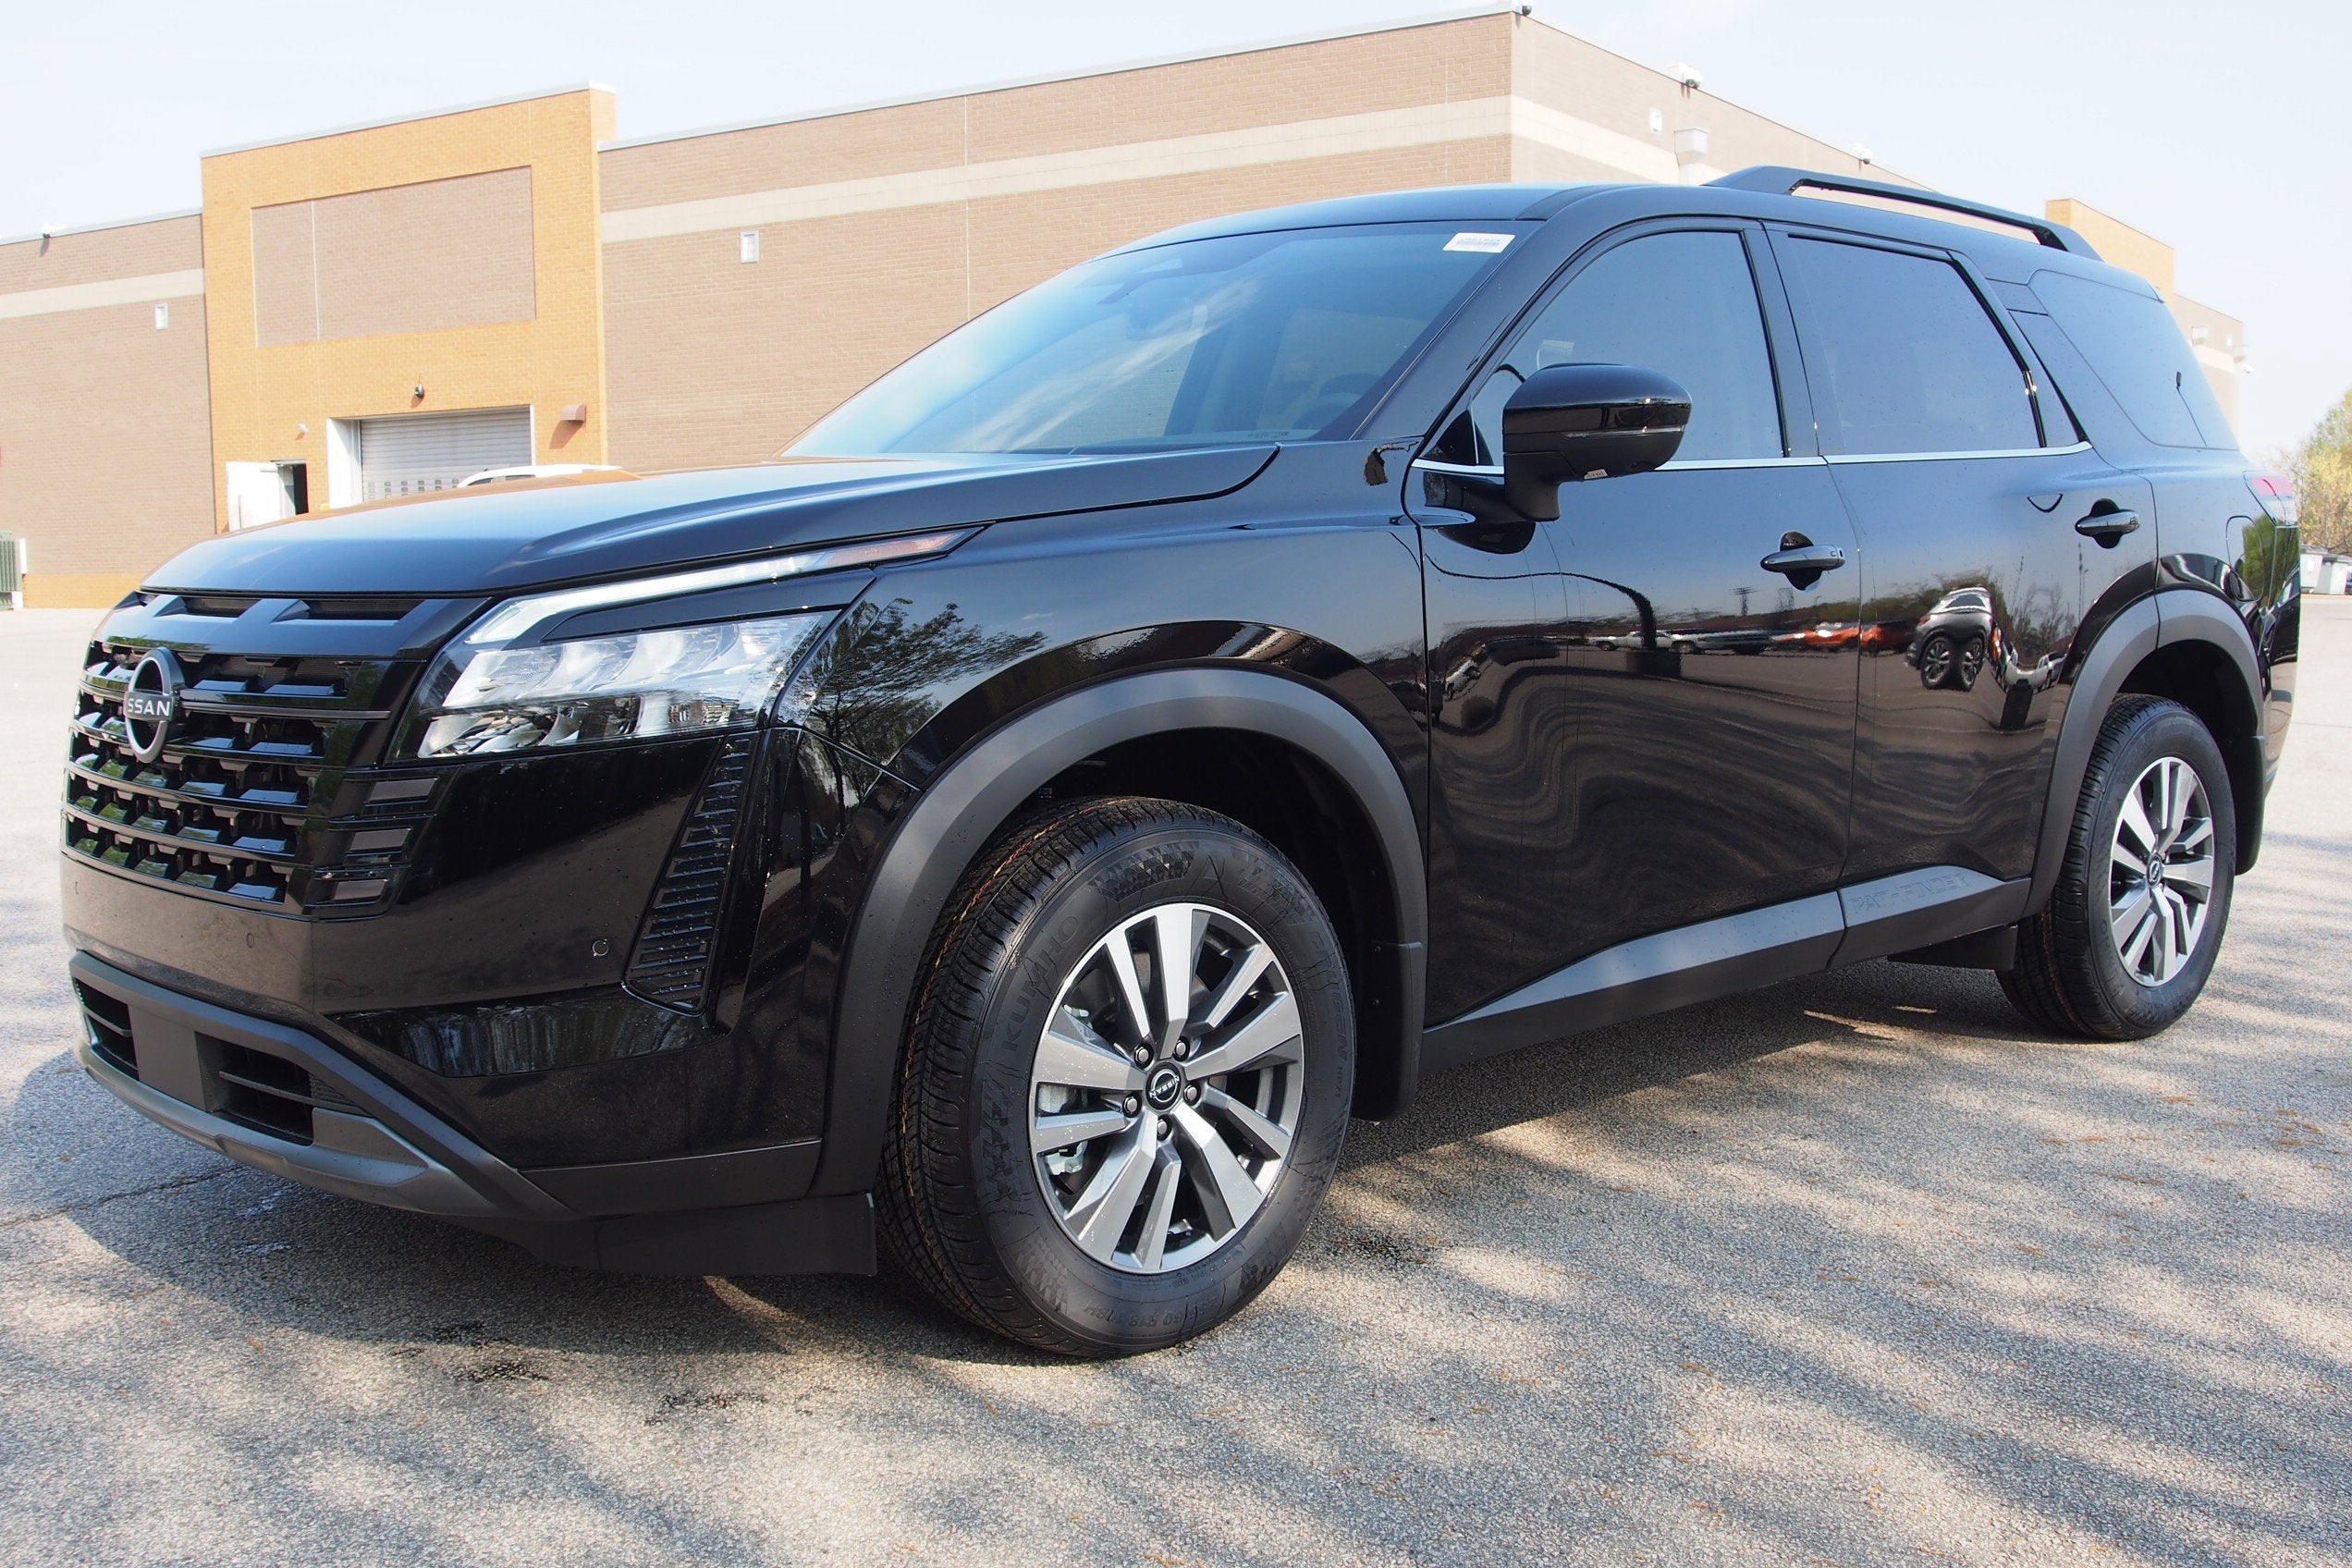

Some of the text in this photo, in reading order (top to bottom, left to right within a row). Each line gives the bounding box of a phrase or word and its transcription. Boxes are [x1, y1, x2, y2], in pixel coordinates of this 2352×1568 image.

[128, 697, 170, 717] SSAN
[1000, 915, 1079, 1052] KUMHO
[1148, 1074, 1180, 1098] NISSAN
